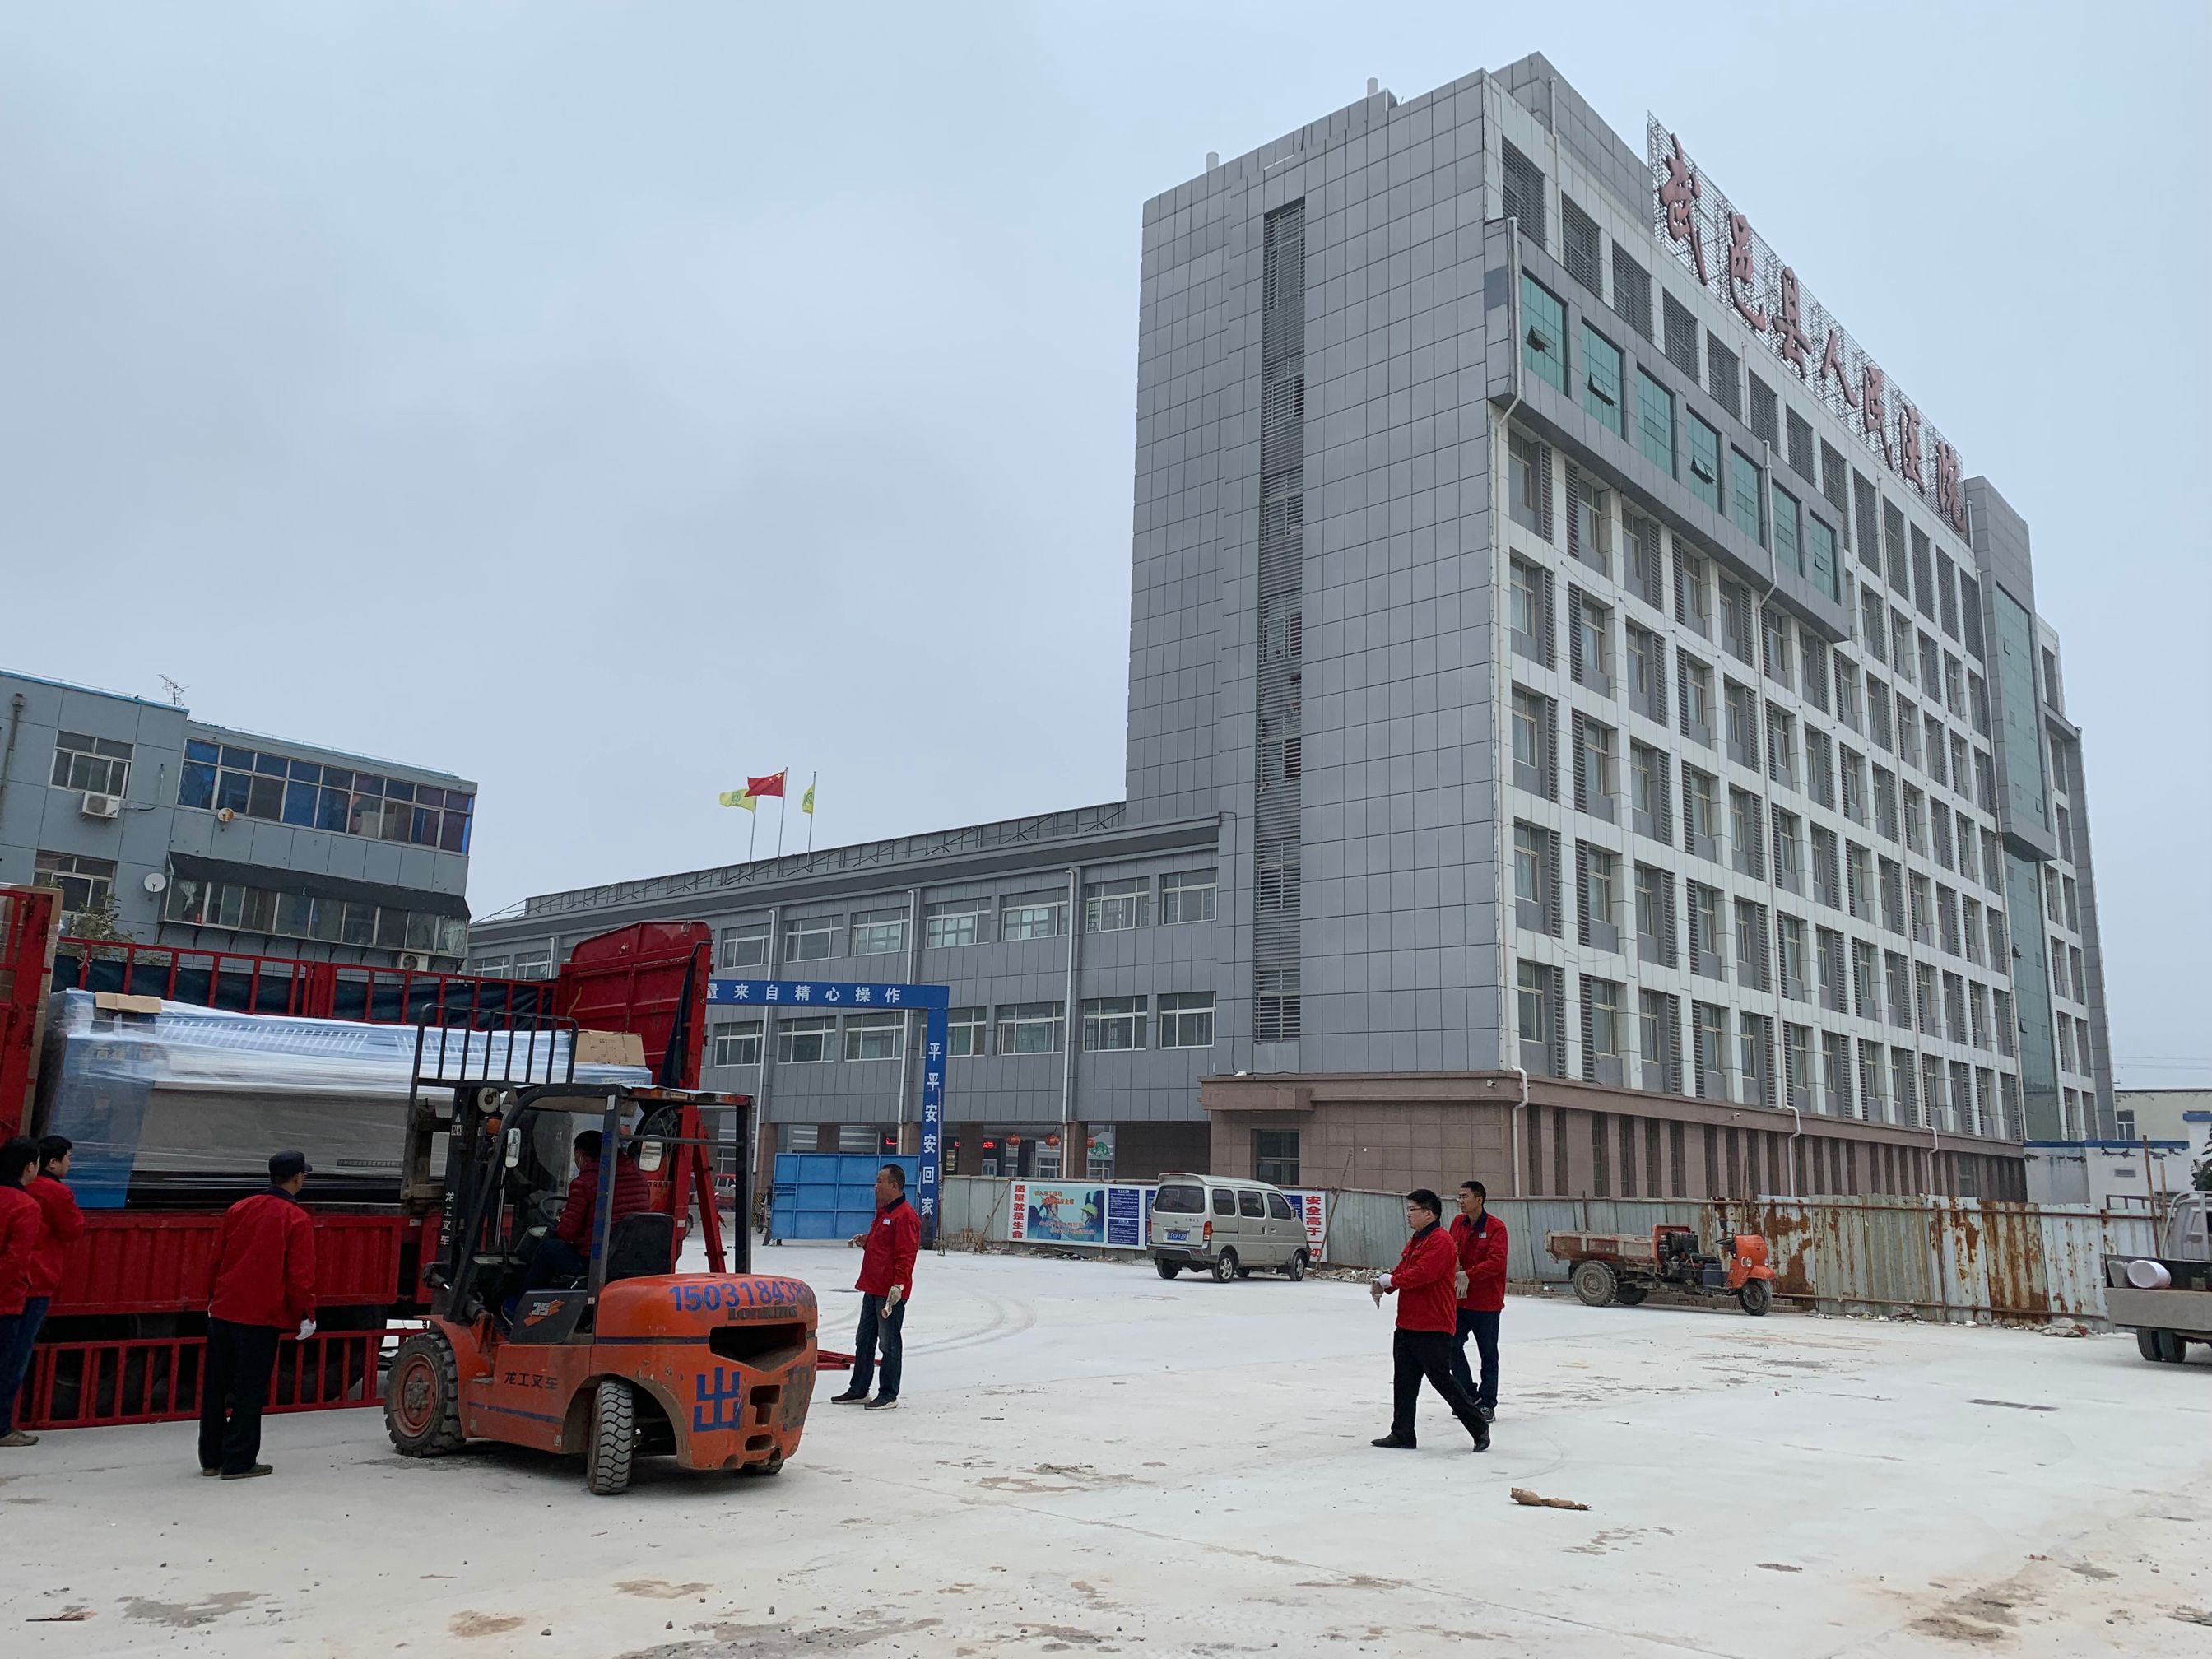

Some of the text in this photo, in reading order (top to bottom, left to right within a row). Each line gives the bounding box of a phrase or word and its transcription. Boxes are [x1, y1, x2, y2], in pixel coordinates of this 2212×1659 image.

[706, 983, 901, 1003] 量来自精心操作
[921, 1042, 941, 1216] 平平安安回家
[440, 1192, 454, 1245] 龙工叉车
[1012, 1184, 1025, 1238] 质量就是生命
[504, 1371, 559, 1391] 龙工叉车
